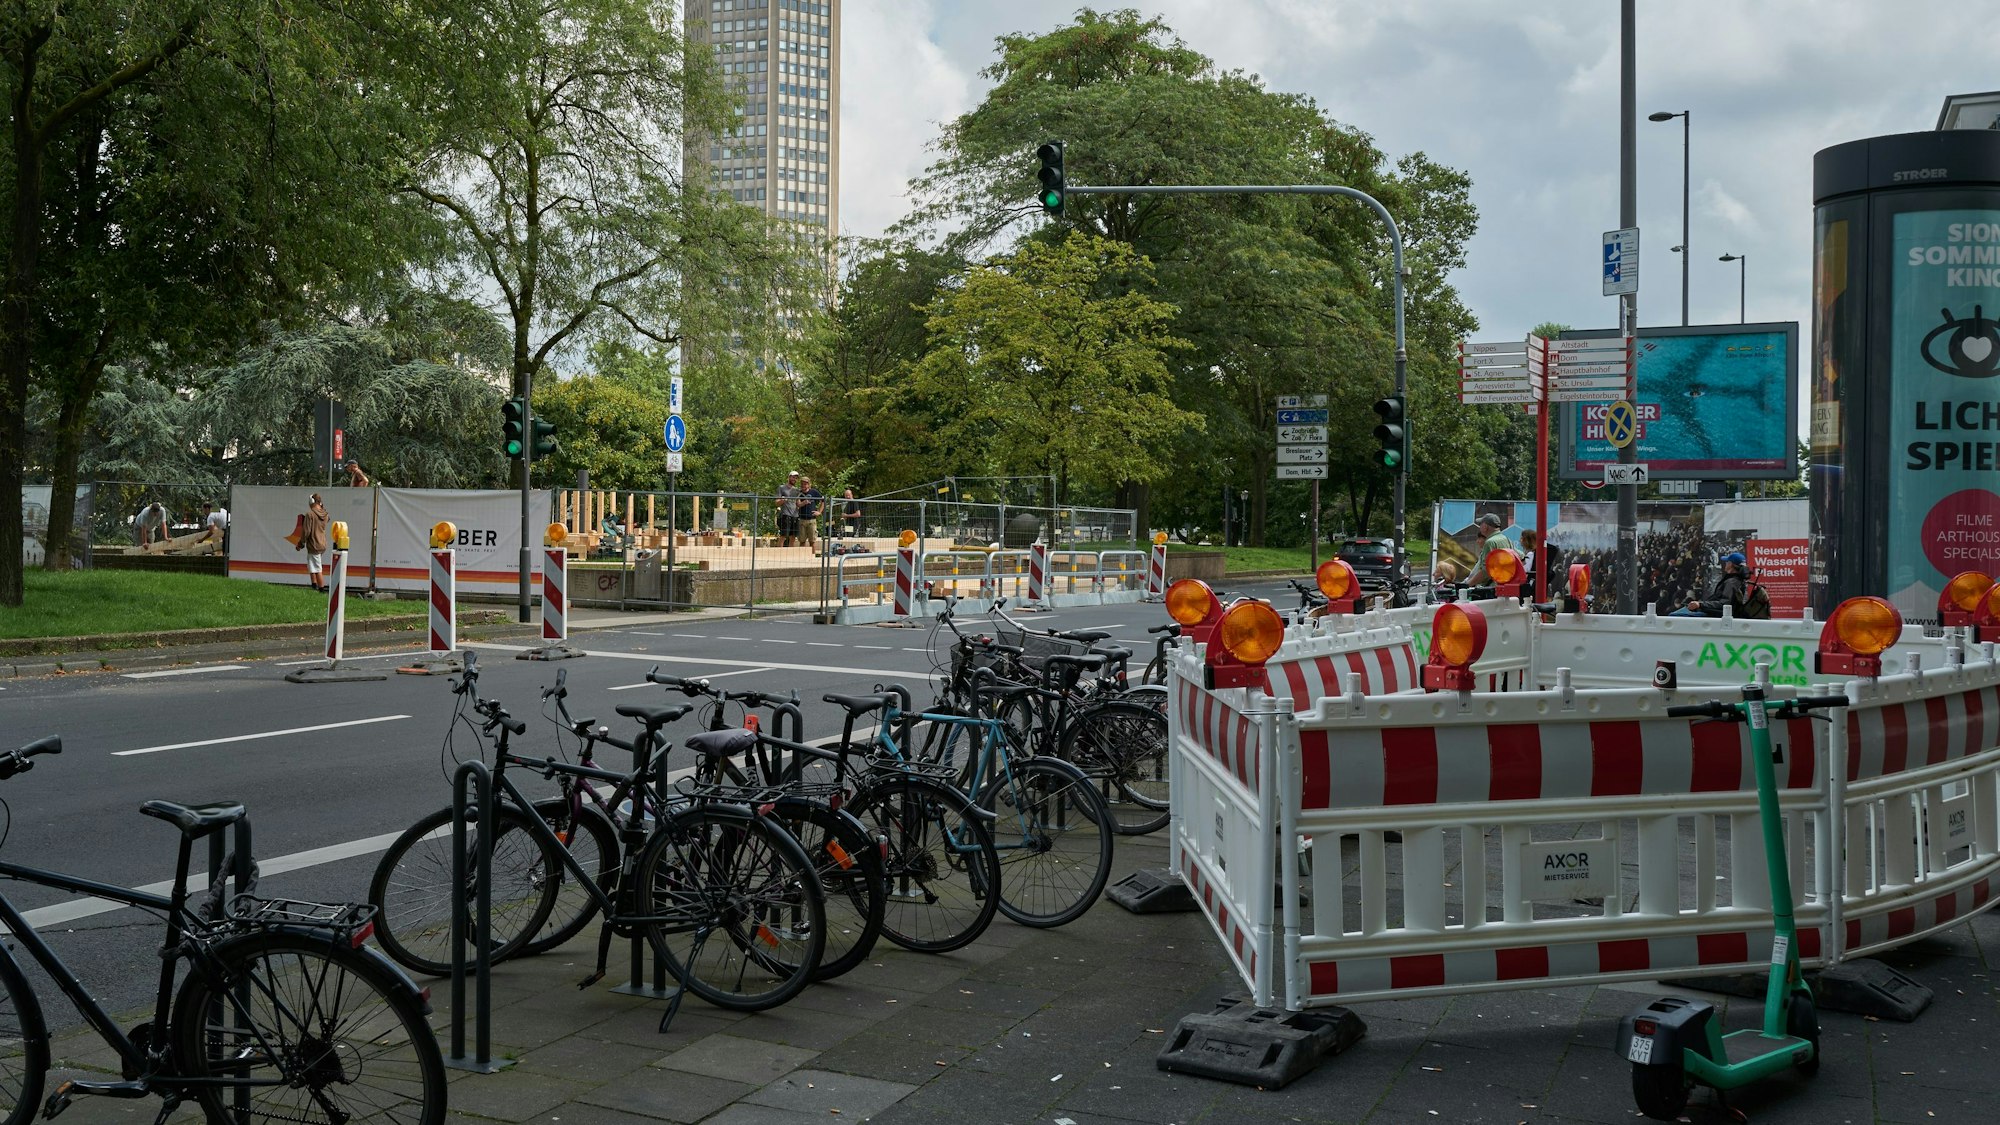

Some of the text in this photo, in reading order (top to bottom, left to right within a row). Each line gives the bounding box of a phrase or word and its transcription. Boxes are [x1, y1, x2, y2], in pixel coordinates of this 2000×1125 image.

[1893, 168, 1948, 182] STRÖER
[1473, 345, 1497, 353] Nippes
[1561, 341, 1589, 349] Altstadt
[1484, 370, 1505, 378] Agnes
[1560, 366, 1611, 375] Hauptbahnhof
[1473, 382, 1516, 391] Agnesviertel
[1488, 394, 1529, 402] Feuerwache
[1560, 392, 1620, 400] Eigelsteintorburg
[1587, 403, 1656, 420] KÖER
[1907, 441, 2000, 470] SPIE
[1609, 469, 1627, 480] WC
[1956, 515, 1992, 526] FILME
[1754, 546, 1789, 555] Neuer
[1944, 547, 2000, 559] SPECIALS
[1754, 556, 1808, 566] Wasserki
[1754, 568, 1795, 577] Plastik
[1696, 642, 1806, 672] AXOR
[1949, 810, 1965, 827] AXOR
[1544, 853, 1589, 869] AXOR
[1544, 872, 1590, 881] MIETSERVICE
[1633, 1037, 1650, 1051] 375
[1630, 1049, 1649, 1062] KYT
